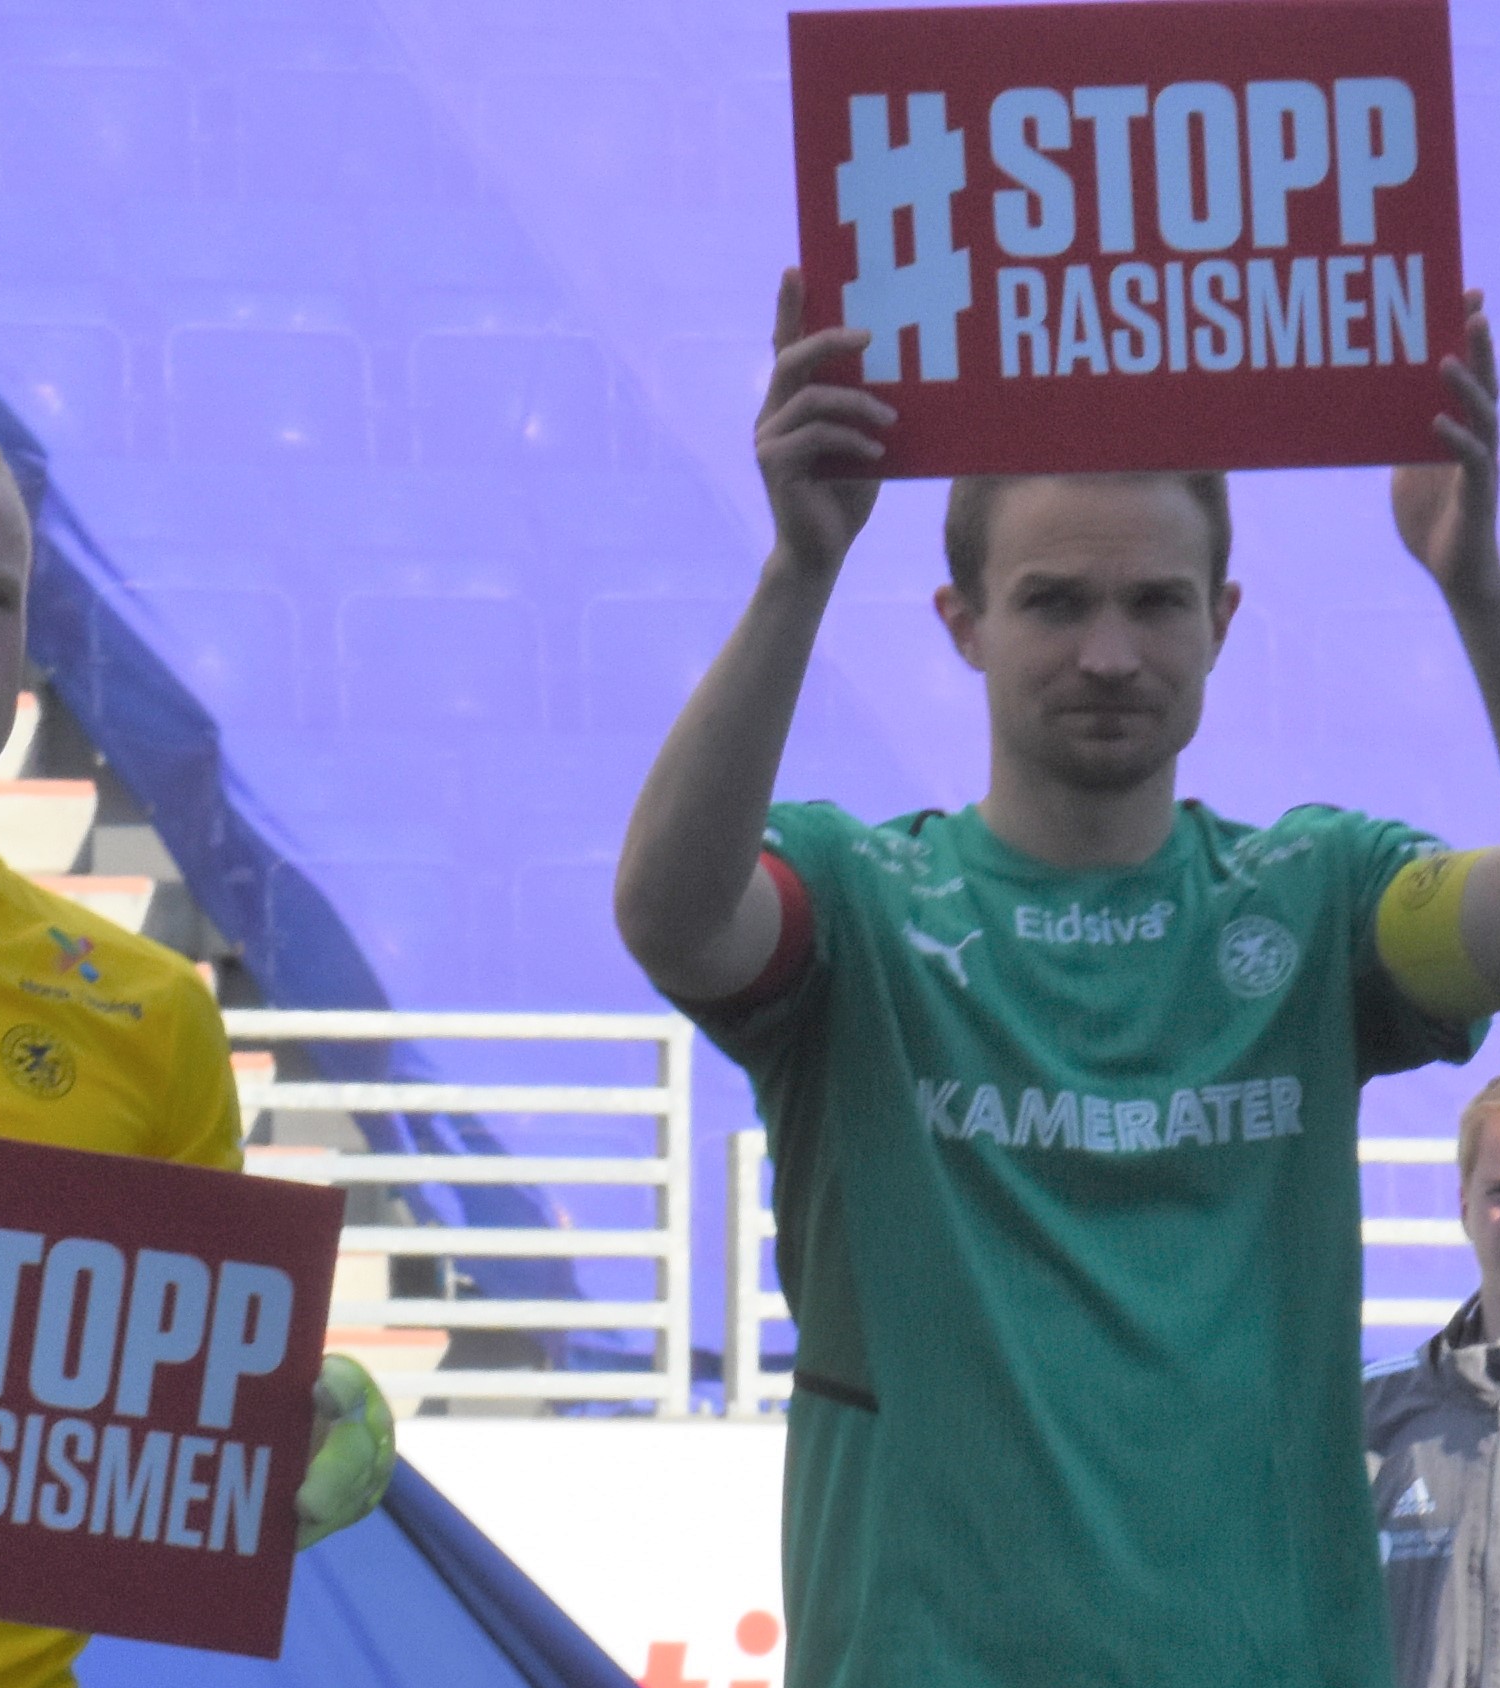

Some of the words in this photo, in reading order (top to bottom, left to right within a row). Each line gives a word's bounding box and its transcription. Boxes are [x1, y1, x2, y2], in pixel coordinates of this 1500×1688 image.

[996, 253, 1429, 379] RASISMEN
[1014, 903, 1166, 946] Eidsiva
[918, 1075, 1304, 1153] KAMERATER
